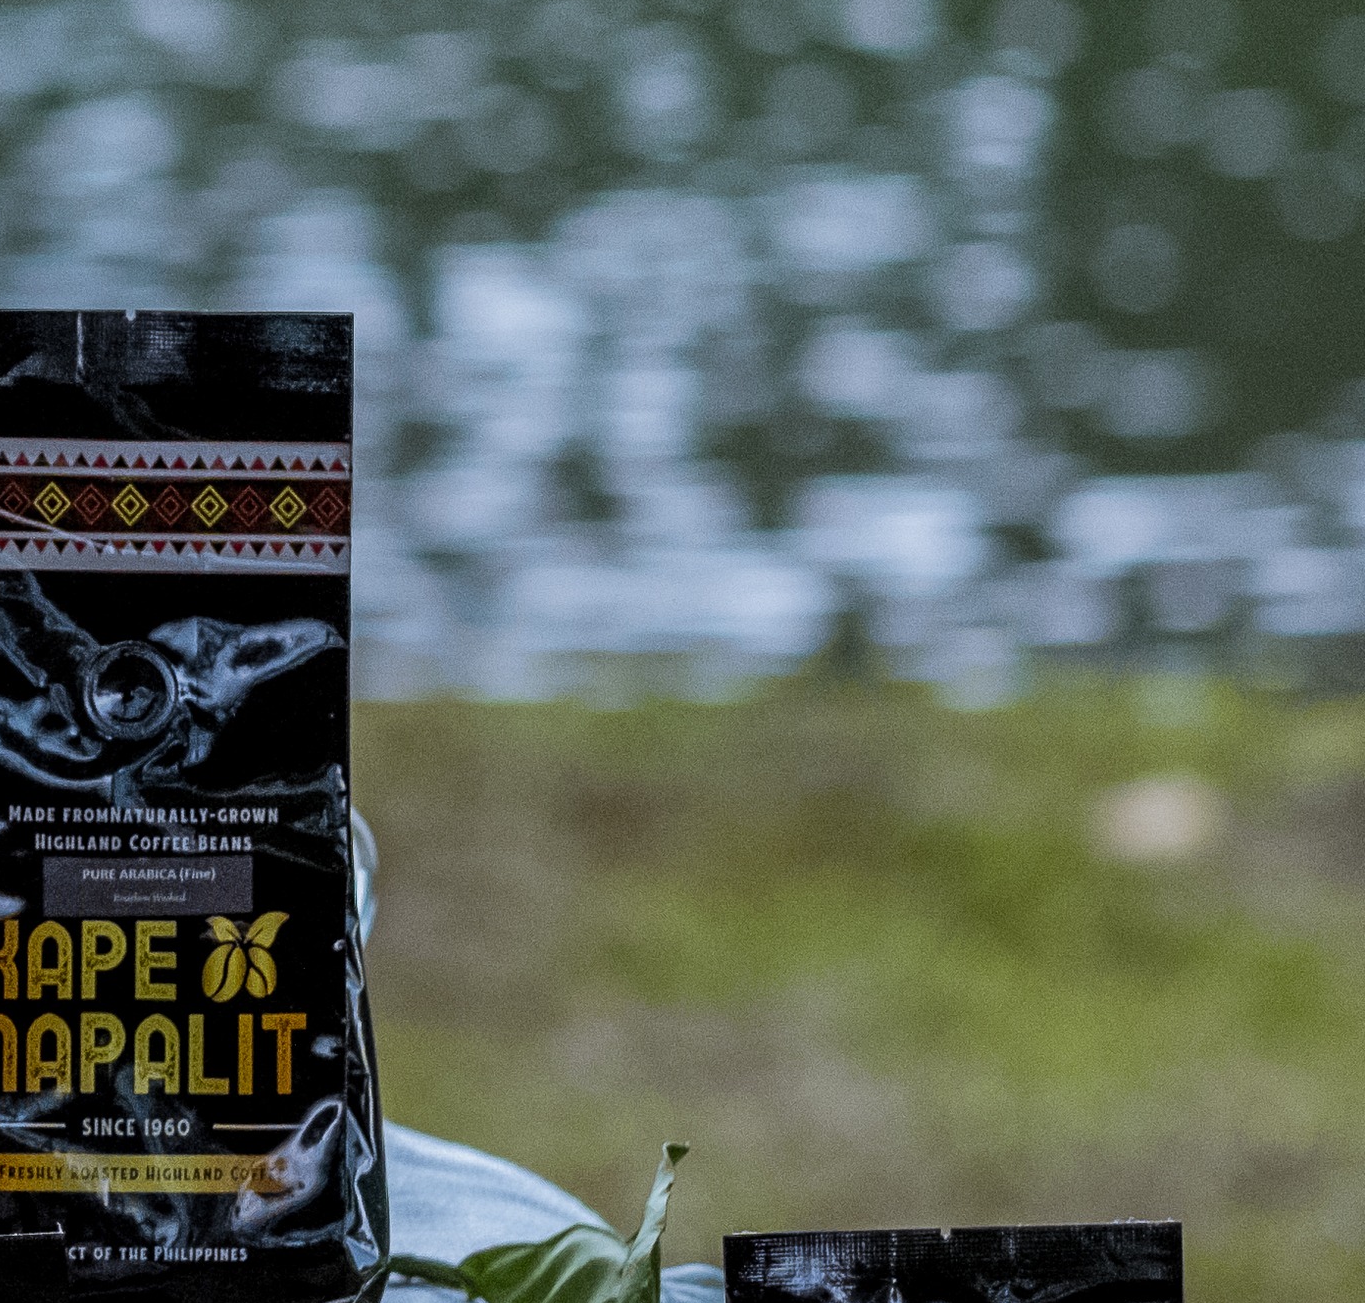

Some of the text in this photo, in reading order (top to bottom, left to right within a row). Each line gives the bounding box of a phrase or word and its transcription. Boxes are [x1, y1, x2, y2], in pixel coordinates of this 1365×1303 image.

[9, 805, 55, 822] MADE
[35, 833, 252, 852] HIGHLAND COFFEE BEANS
[83, 869, 115, 881] PURE
[119, 869, 177, 881] ARABICA
[82, 1118, 190, 1136] SINCE 1960
[0, 1164, 62, 1180] FRESHLY
[146, 1164, 222, 1180] HIGHLAND
[94, 1247, 112, 1260] OF
[119, 1246, 146, 1261] THE
[154, 1247, 247, 1262] PHILIPPINES
